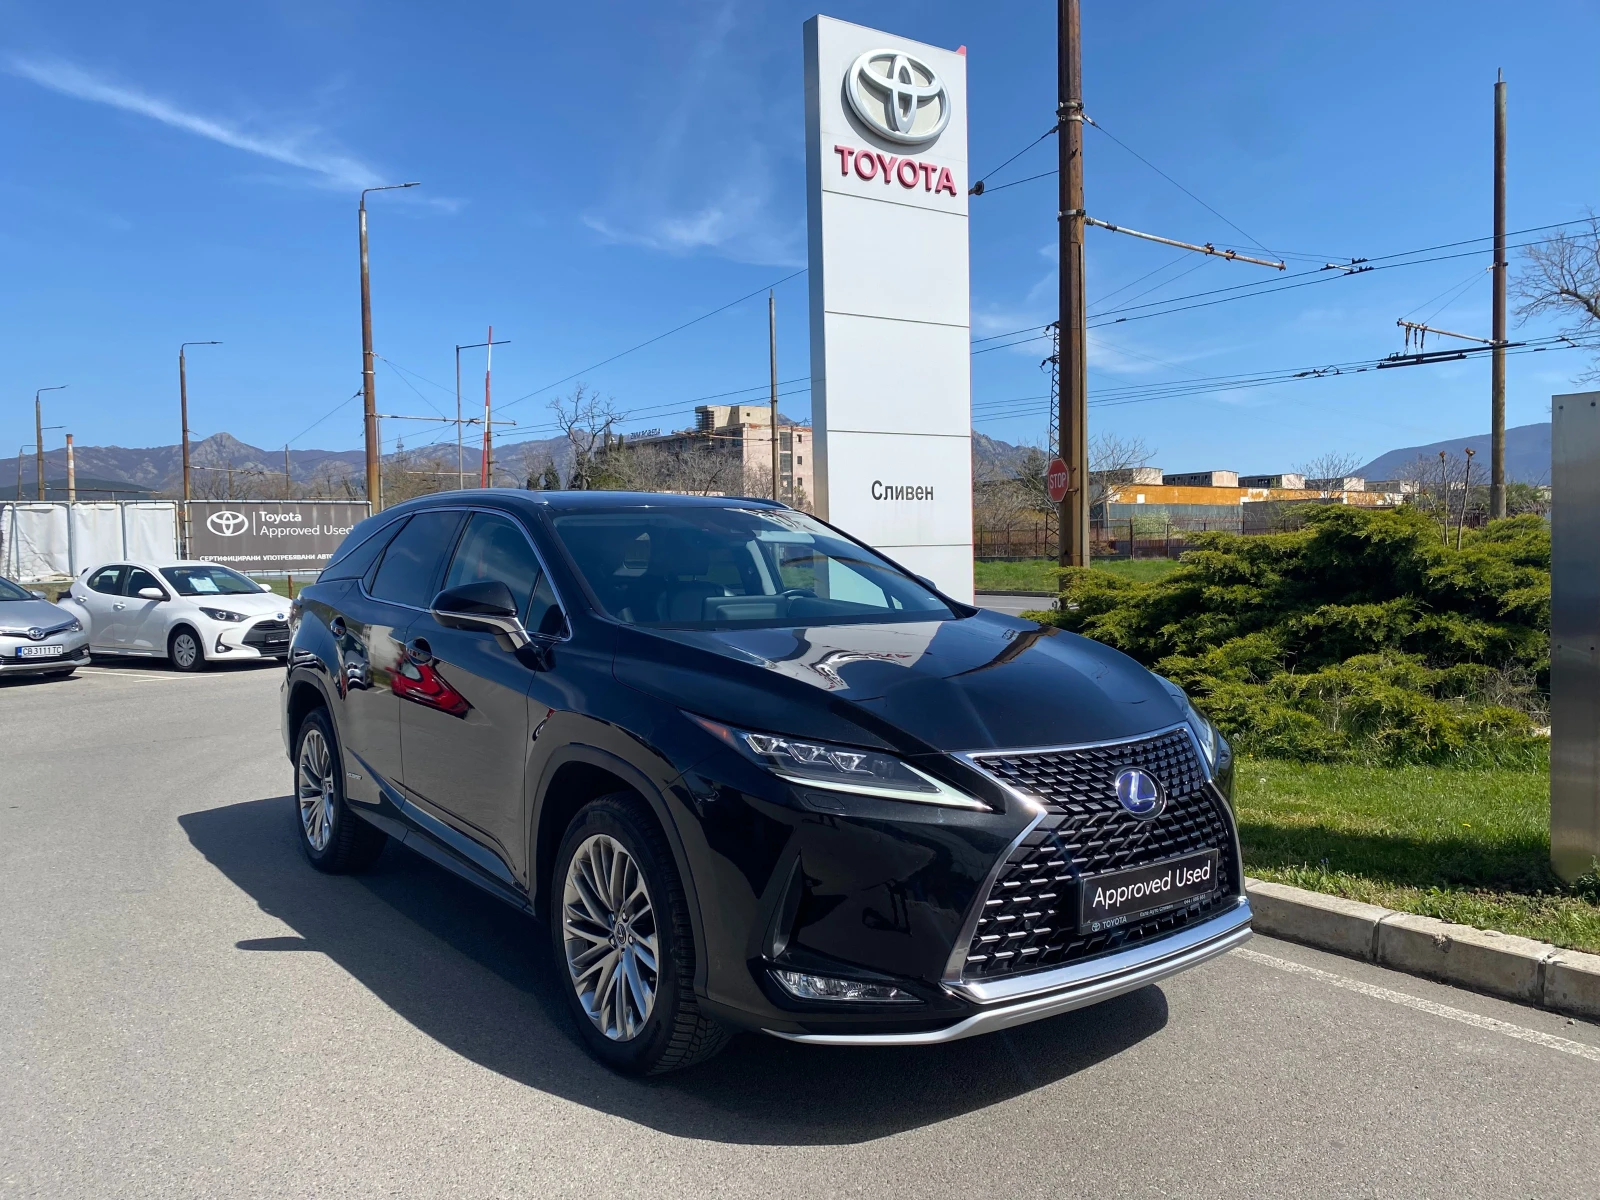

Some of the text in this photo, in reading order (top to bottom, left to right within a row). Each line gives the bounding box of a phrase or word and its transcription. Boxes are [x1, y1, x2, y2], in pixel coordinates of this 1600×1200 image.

[834, 144, 957, 197] TOYOTA
[1050, 472, 1067, 489] STOP
[871, 479, 934, 501] Сливен
[259, 511, 303, 524] Toyota
[260, 524, 320, 538] Approved
[199, 554, 261, 563] СЕРТИФИЦИРАНИ
[263, 553, 316, 561] УПОТРЕБЯВАНИ
[1092, 859, 1211, 910] Approved Used
[1102, 915, 1128, 929] TOYOTA
